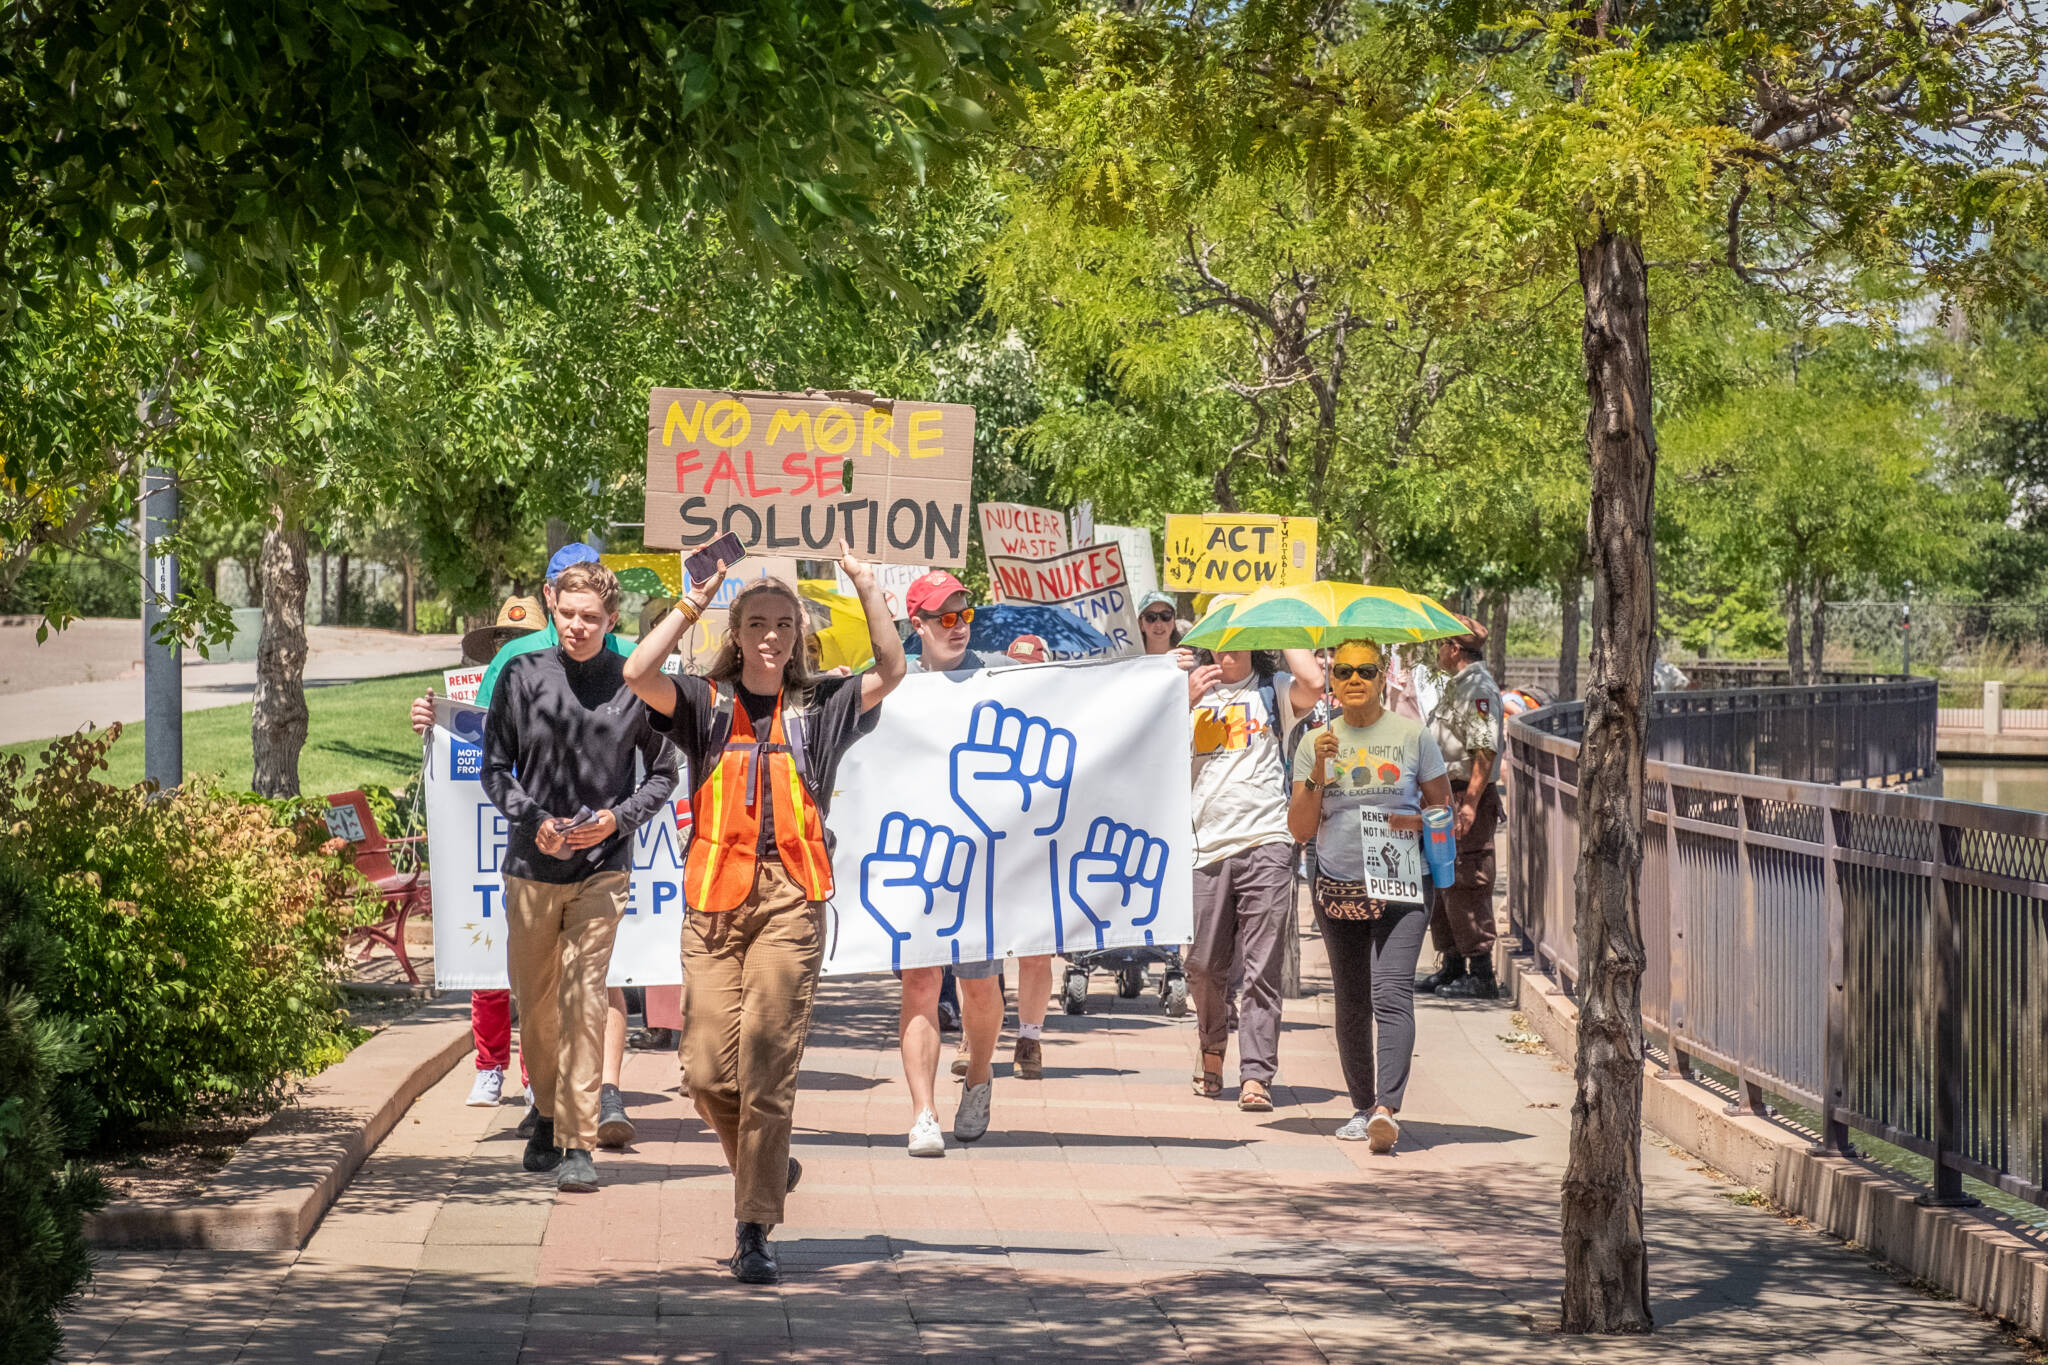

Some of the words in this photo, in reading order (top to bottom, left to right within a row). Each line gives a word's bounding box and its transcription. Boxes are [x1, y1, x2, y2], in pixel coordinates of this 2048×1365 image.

[662, 399, 751, 448] NO
[765, 407, 945, 460] MORE
[675, 449, 844, 498] FALSE
[680, 496, 963, 560] SOLUTION
[985, 509, 1062, 538] NUCLEAR
[1206, 526, 1275, 554] ACT
[999, 566, 1033, 599] NO
[1037, 547, 1122, 600] NUKES
[1204, 559, 1278, 582] NOW
[451, 691, 469, 701] NOT
[457, 757, 476, 766] OUT
[1368, 745, 1391, 759] LIGHT
[1393, 745, 1405, 764] ON
[1363, 827, 1378, 837] NOT
[1380, 828, 1415, 841] NUCLEAR
[1370, 879, 1418, 898] PUEBLO
